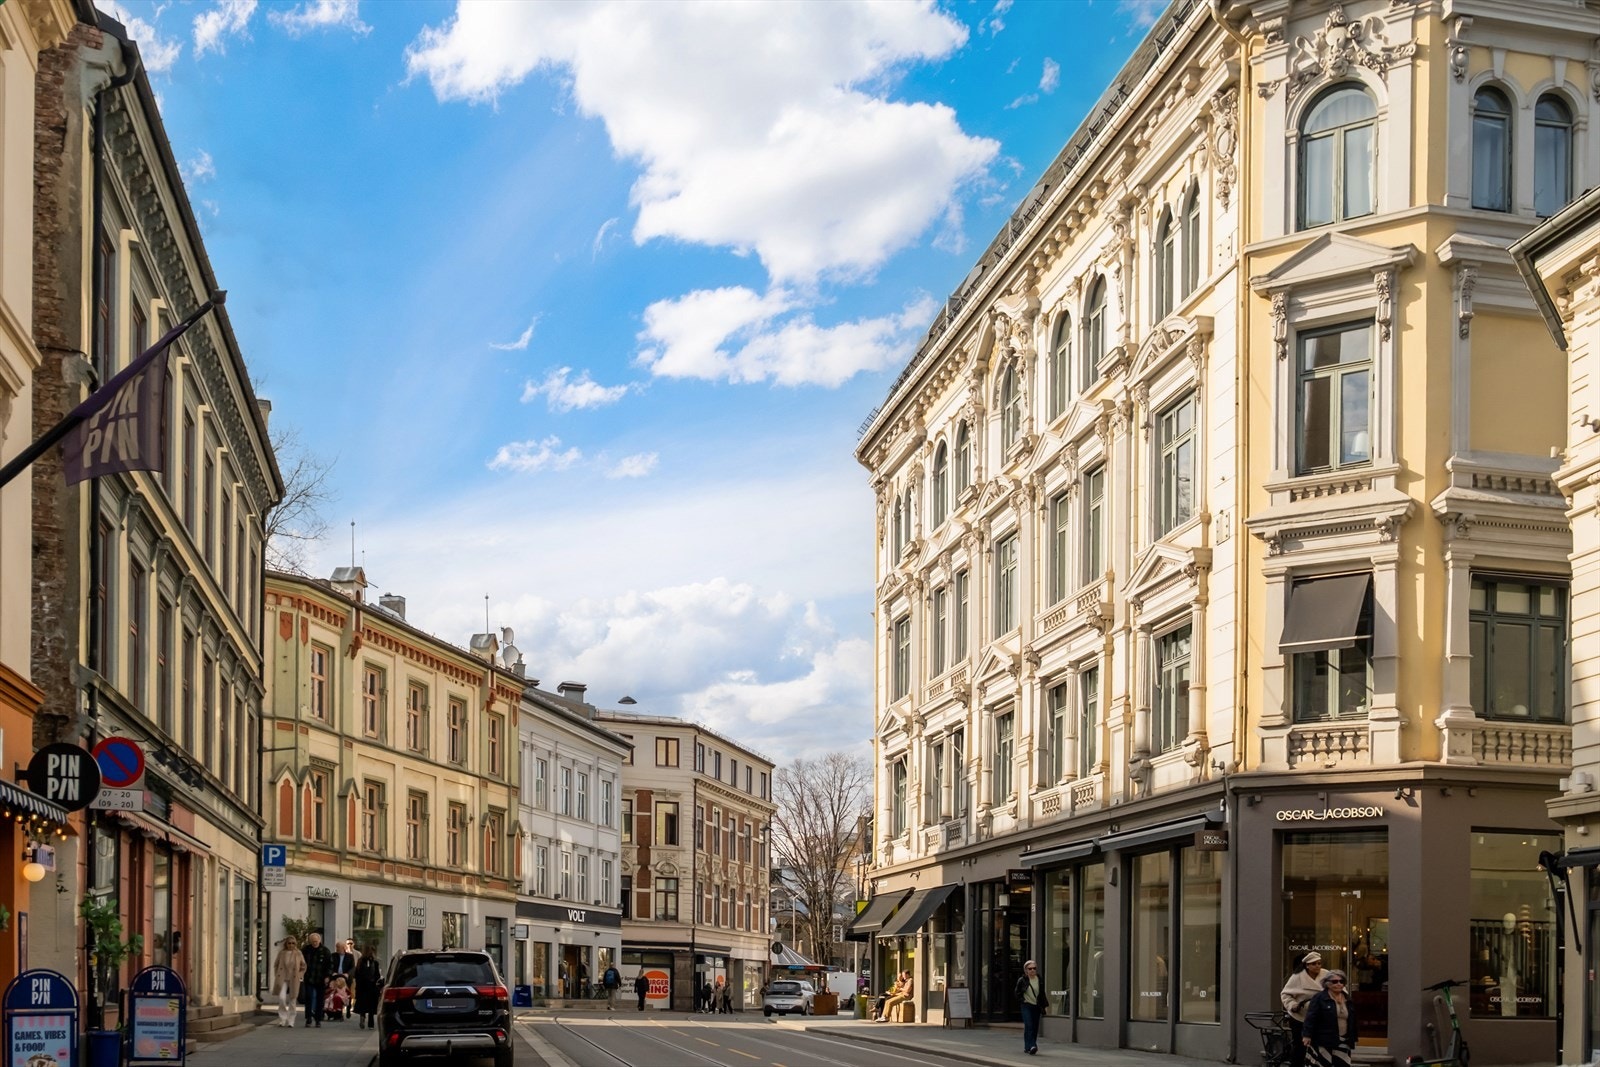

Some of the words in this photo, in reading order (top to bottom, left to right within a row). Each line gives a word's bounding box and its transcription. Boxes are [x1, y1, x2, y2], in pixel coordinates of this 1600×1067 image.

[47, 754, 80, 777] PIN
[98, 799, 112, 808] (09
[120, 800, 134, 809] 20)
[1276, 809, 1320, 821] OSCAR
[1321, 806, 1383, 820] JACOBSON
[268, 847, 281, 864] P
[567, 909, 586, 923] VOLT
[151, 970, 166, 980] PIN
[31, 978, 51, 991] PIN
[647, 985, 669, 994] ING
[44, 1030, 67, 1039] VIBES
[14, 1042, 21, 1052] &
[22, 1042, 46, 1052] FOOD!
